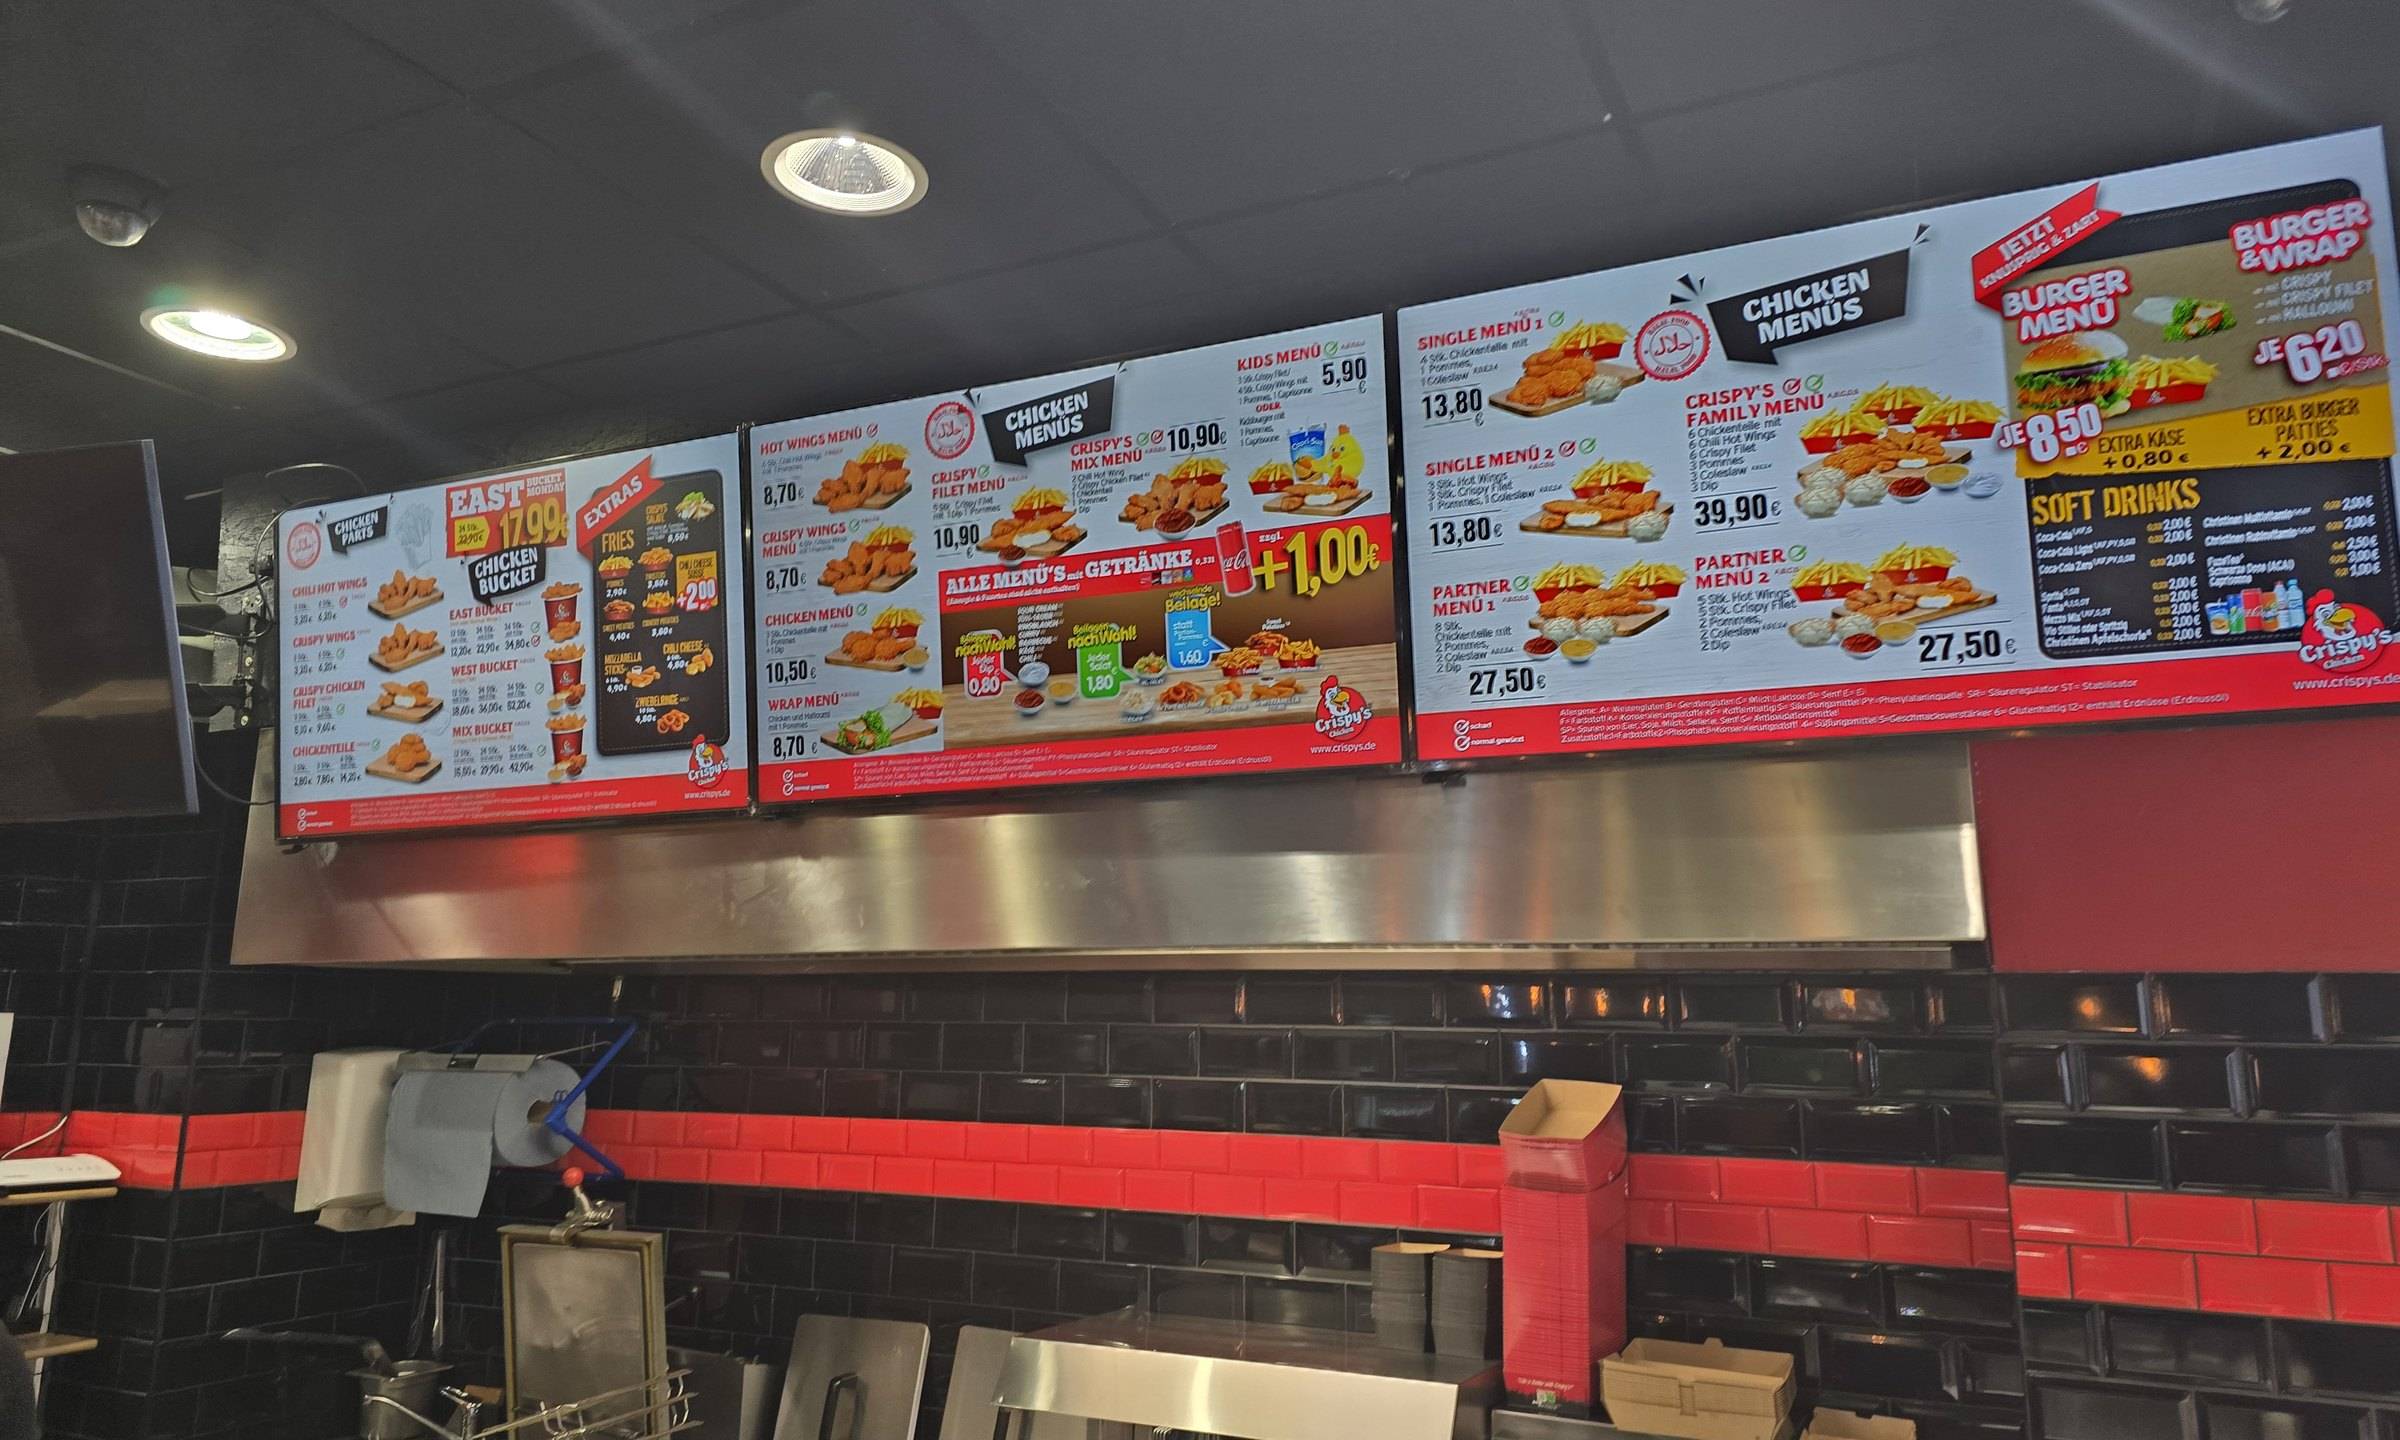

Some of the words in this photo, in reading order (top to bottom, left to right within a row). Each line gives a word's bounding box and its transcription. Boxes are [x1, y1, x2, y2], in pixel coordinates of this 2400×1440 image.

[2051, 235, 2064, 247] &
[2062, 208, 2101, 239] ZART
[2233, 200, 2369, 252] BURGER
[1997, 216, 2056, 261] JETZT
[2281, 270, 2332, 291] CRISPY
[2281, 285, 2331, 305] CRISPY
[2334, 278, 2375, 298] FILET
[1742, 268, 1871, 323] CHICKEN
[2002, 269, 2129, 318] BURGER
[1417, 327, 1478, 351] SINGLE
[1480, 312, 1531, 341] MENÜ
[1757, 297, 1865, 345] MENÜS
[2020, 297, 2116, 342] MENÜ
[1236, 354, 1274, 372] KIDS
[1276, 343, 1322, 364] MENÜ
[2254, 338, 2285, 366] JE
[1322, 358, 1368, 388] 5,90
[1421, 388, 1483, 420] 13,80
[1685, 383, 1776, 410] CRISPY'S
[1005, 391, 1089, 432] CHICKEN
[1686, 403, 1762, 428] FAMILY
[1764, 390, 1825, 418] MENÜ
[2248, 403, 2297, 427] EXTRA
[2300, 397, 2360, 420] BURGER
[1014, 413, 1085, 451] MENÜS
[1168, 423, 1220, 452] 10,90
[1697, 420, 1761, 438] Chickenteile
[1764, 417, 1783, 429] mit
[1722, 434, 1742, 446] Hot
[1745, 429, 1777, 444] Wings
[1999, 422, 2027, 449] JE
[2275, 418, 2339, 442] PATTIES
[760, 439, 784, 456] HOT
[787, 432, 826, 448] WINGS
[827, 425, 863, 443] MENÜ
[1070, 436, 1133, 457] CRISPY'S
[1699, 446, 1732, 461] Crispy
[1733, 442, 1757, 454] Filet
[2098, 434, 2145, 454] EXTRA
[2148, 427, 2186, 448] KÄSE
[2278, 440, 2333, 460] 2,00
[1071, 456, 1100, 472] MIX
[1102, 447, 1143, 467] MENÜ
[1424, 455, 1486, 477] SINGLE
[1488, 443, 1540, 468] MENÜ
[1543, 448, 1555, 460] 2
[1699, 456, 1745, 470] Pommes
[2122, 449, 2174, 470] 0,80
[526, 473, 562, 486] BUCKET
[930, 467, 977, 485] CRISPY
[1700, 466, 1748, 481] Coleslaw
[526, 482, 566, 497] MONDAY
[764, 482, 797, 508] 8,70
[932, 483, 965, 499] FILET
[967, 475, 1006, 493] MENÜ
[1700, 480, 1719, 493] Dip
[450, 480, 525, 518] EAST
[583, 475, 643, 529] EXTRAS
[1695, 494, 1768, 528] 39,90
[2031, 488, 2096, 526] SOFT
[2102, 477, 2201, 519] DRINKS
[335, 510, 379, 536] CHICKEN
[762, 527, 804, 545] CRISPY
[807, 522, 846, 537] WINGS
[1429, 517, 1491, 547] 13,80
[341, 525, 374, 546] PARTS
[602, 529, 635, 553] FRIES
[933, 523, 980, 551] 10,90
[1259, 531, 1284, 543] zzgl.
[762, 542, 797, 558] MENÜ
[1695, 548, 1787, 572] PARTNER
[474, 546, 538, 579] CHICKEN
[945, 576, 991, 596] ALLE
[993, 564, 1067, 590] MENÜ'S
[1085, 549, 1193, 579] GETRÄNKE
[335, 577, 368, 592] WINGS
[478, 565, 537, 595] BUCKET
[766, 567, 799, 591] 8,70
[1432, 578, 1512, 600] PARTNER
[1695, 567, 1753, 590] MENÜ
[1758, 572, 1770, 584] 2
[1165, 592, 1221, 613] Beilage!
[1433, 596, 1484, 617] MENÜ
[1732, 601, 1770, 614] Crispy
[1771, 599, 1798, 611] Filet
[1755, 588, 1792, 601] Wings
[450, 607, 474, 621] EAST
[475, 602, 513, 617] BUCKET
[765, 610, 816, 628] CHICKEN
[818, 605, 854, 620] MENÜ
[326, 630, 356, 644] WINGS
[1710, 640, 1731, 653] Dip
[1918, 628, 2002, 665] 27,50
[2300, 628, 2393, 663] Crispy's
[451, 663, 477, 677] WEST
[479, 658, 518, 674] BUCKET
[766, 659, 808, 685] 10,50
[1445, 662, 1462, 673] Dip
[2323, 654, 2365, 670] Chicken
[325, 679, 366, 694] CHICKEN
[968, 676, 1000, 697] 0,80
[1086, 676, 1114, 692] 1,80
[1469, 667, 1534, 697] 27,50
[2293, 673, 2400, 690] www.crispys.de
[768, 697, 803, 712] WRAP
[803, 693, 840, 709] MENÜ
[452, 726, 473, 738] MIX
[475, 721, 513, 737] BUCKET
[1315, 706, 1373, 734] Crispy's
[1329, 727, 1355, 739] Chicken
[773, 735, 805, 761] 8,70
[1310, 741, 1377, 755] www.crispys.de
[688, 759, 730, 782] Crispy's
